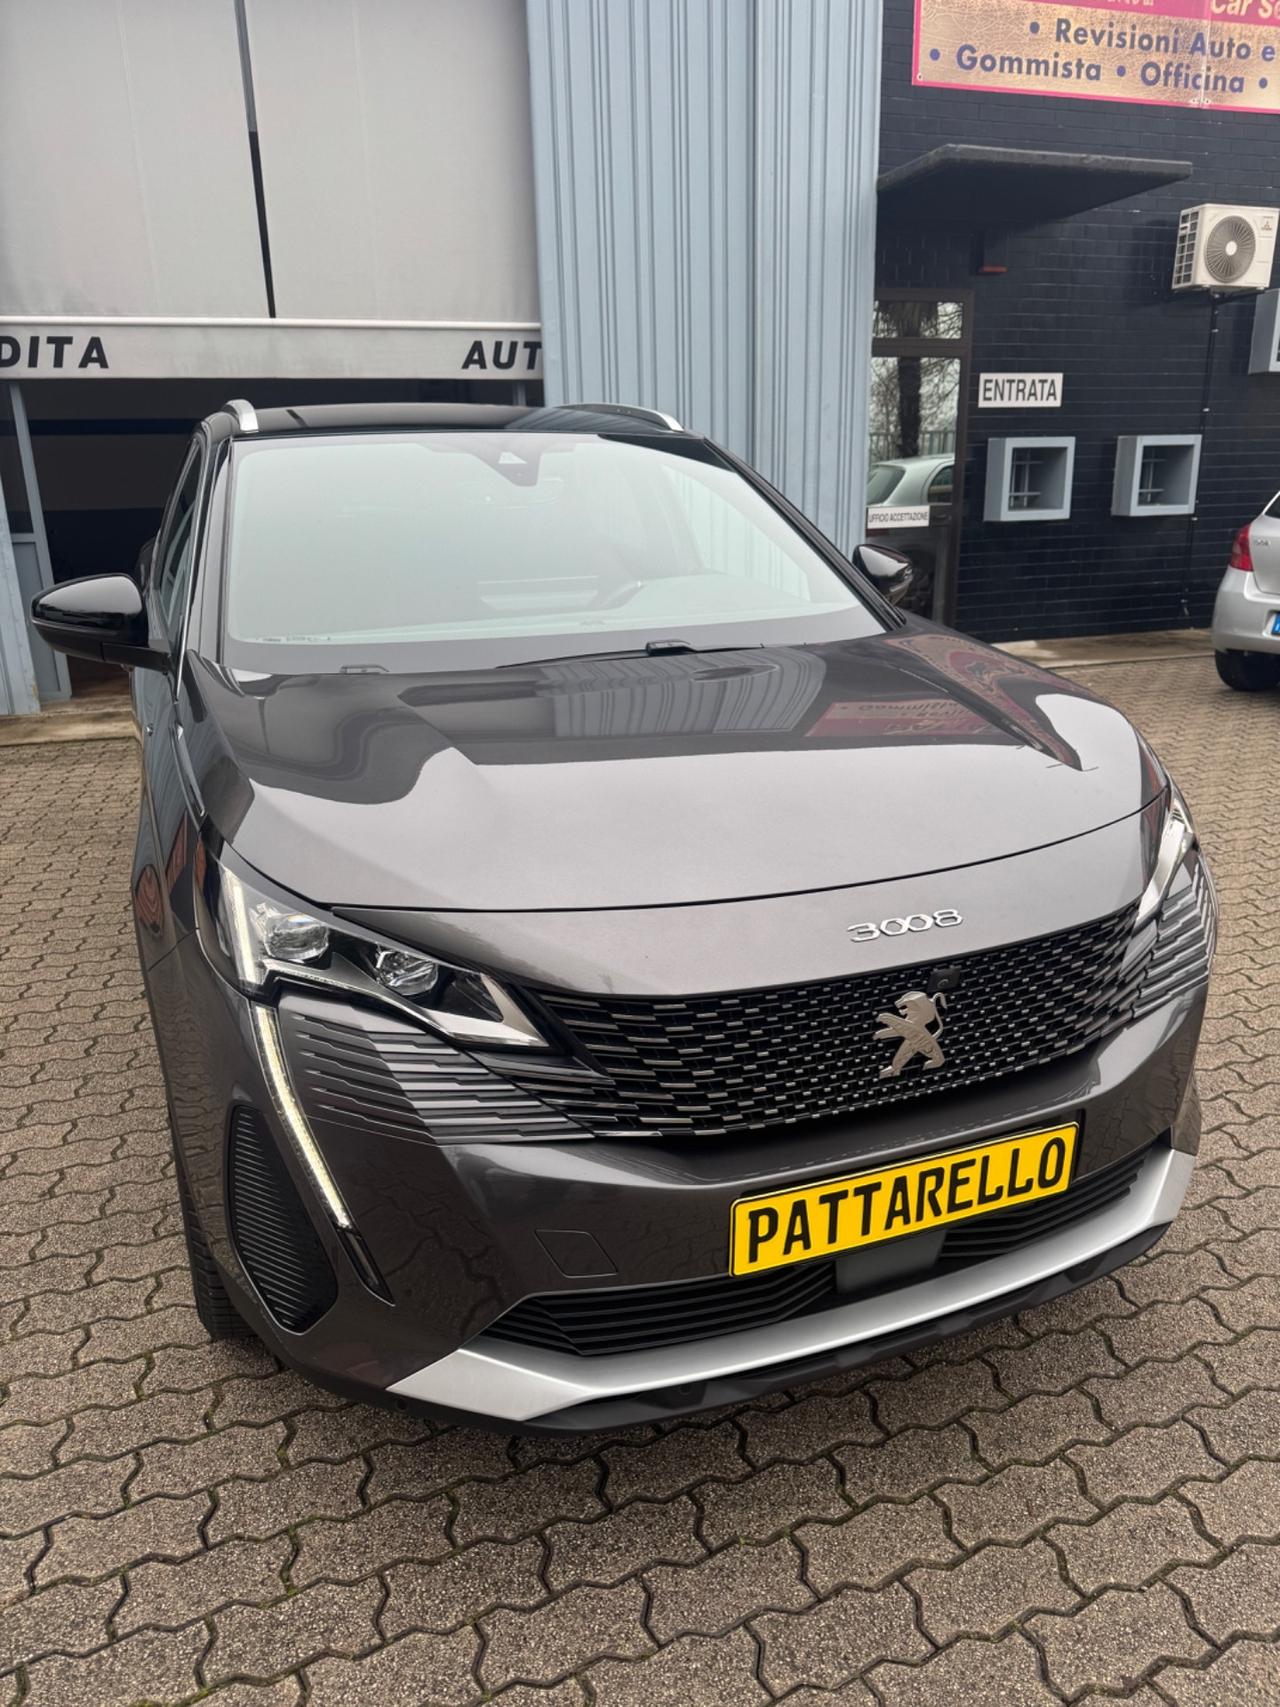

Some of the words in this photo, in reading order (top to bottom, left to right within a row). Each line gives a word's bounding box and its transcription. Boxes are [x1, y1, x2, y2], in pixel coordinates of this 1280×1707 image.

[1055, 17, 1179, 54] Revisioni
[1189, 32, 1251, 60] Auto
[1261, 45, 1276, 62] e
[956, 43, 1102, 81] Gommista
[1140, 61, 1245, 93] Officina
[0, 335, 109, 369] DITA
[461, 340, 542, 370] AUT
[982, 378, 1058, 402] ENTRATA
[869, 512, 889, 523] UFFICIO
[889, 511, 929, 521] ACCETTAZIONE
[846, 908, 964, 943] 3008
[748, 1136, 1066, 1264] PATTARELLO
